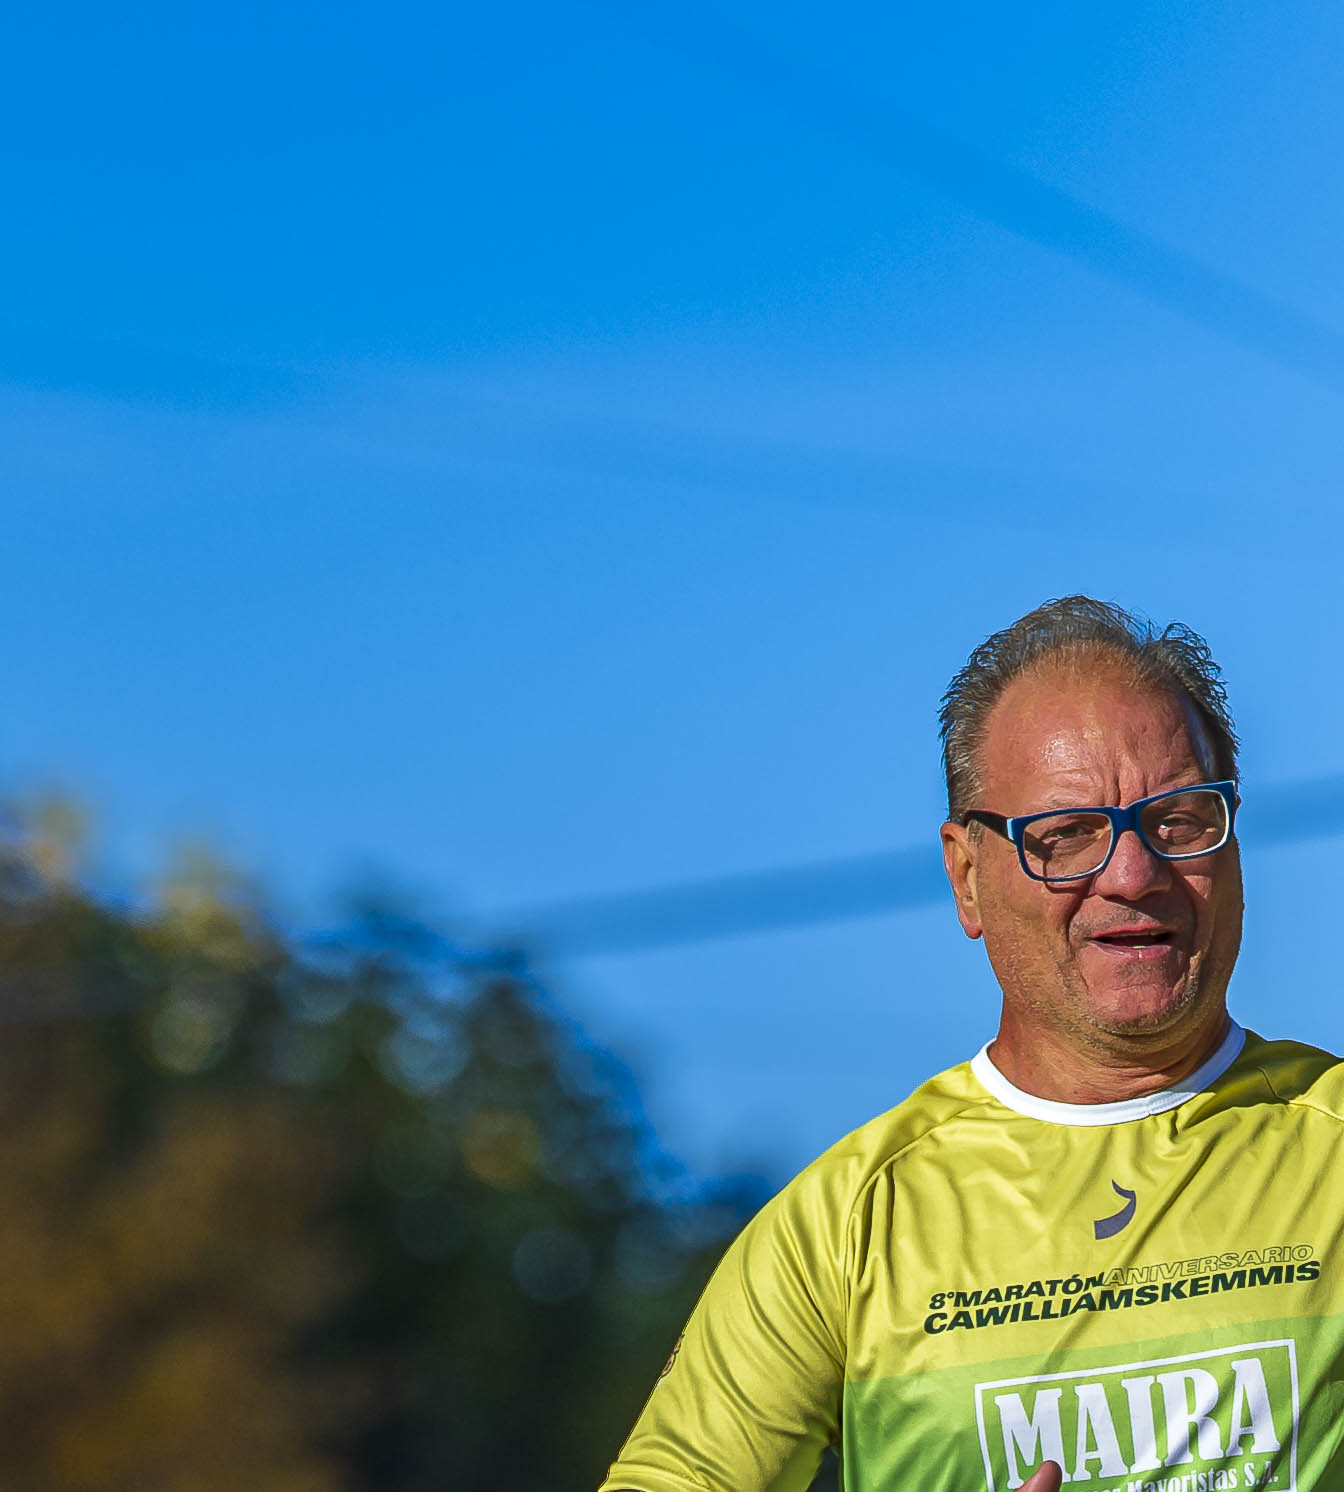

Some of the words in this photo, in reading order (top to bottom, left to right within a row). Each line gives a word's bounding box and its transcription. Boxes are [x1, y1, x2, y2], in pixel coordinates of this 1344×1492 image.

[924, 1261, 1321, 1335] CAWILLIAMSKEMMIS
[1104, 1245, 1314, 1286] ANIVERSARIO
[994, 1358, 1281, 1489] MAIRA
